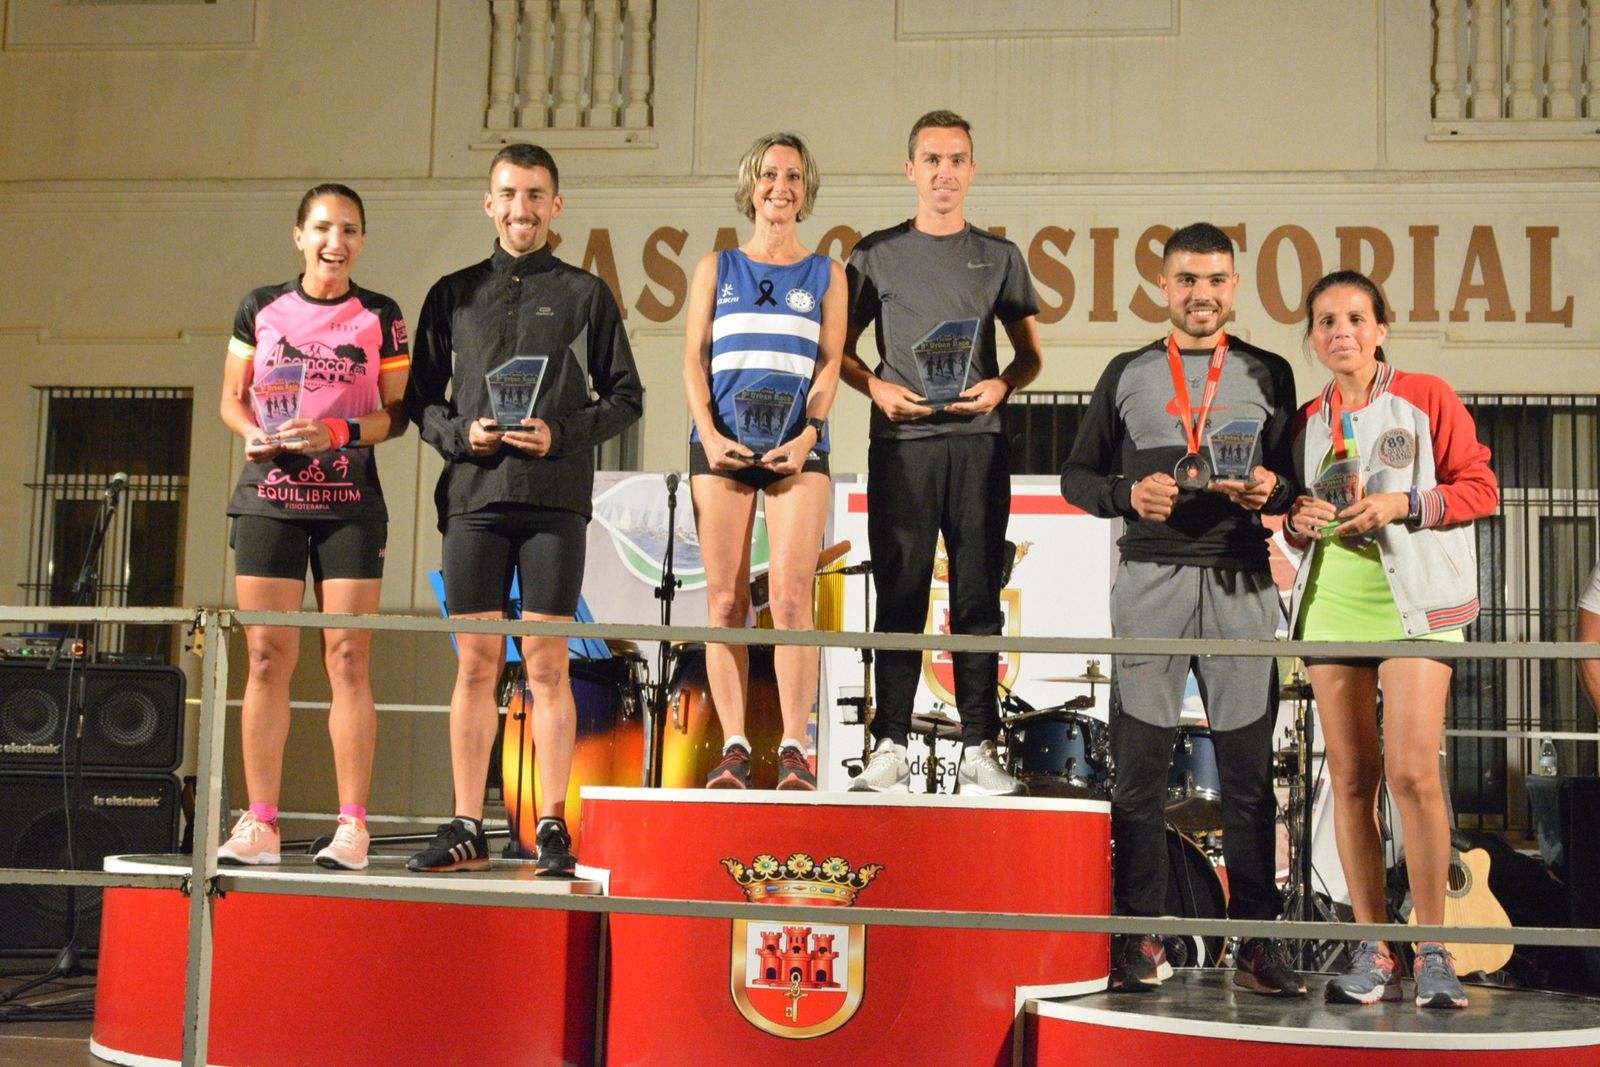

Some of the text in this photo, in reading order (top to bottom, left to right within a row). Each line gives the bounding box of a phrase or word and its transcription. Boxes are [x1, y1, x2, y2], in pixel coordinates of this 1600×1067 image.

[548, 223, 1574, 328] AS SISORIAL
[1387, 435, 1405, 448] 89
[257, 484, 361, 502] EQUILIBRIUM
[105, 795, 160, 807] electronic
